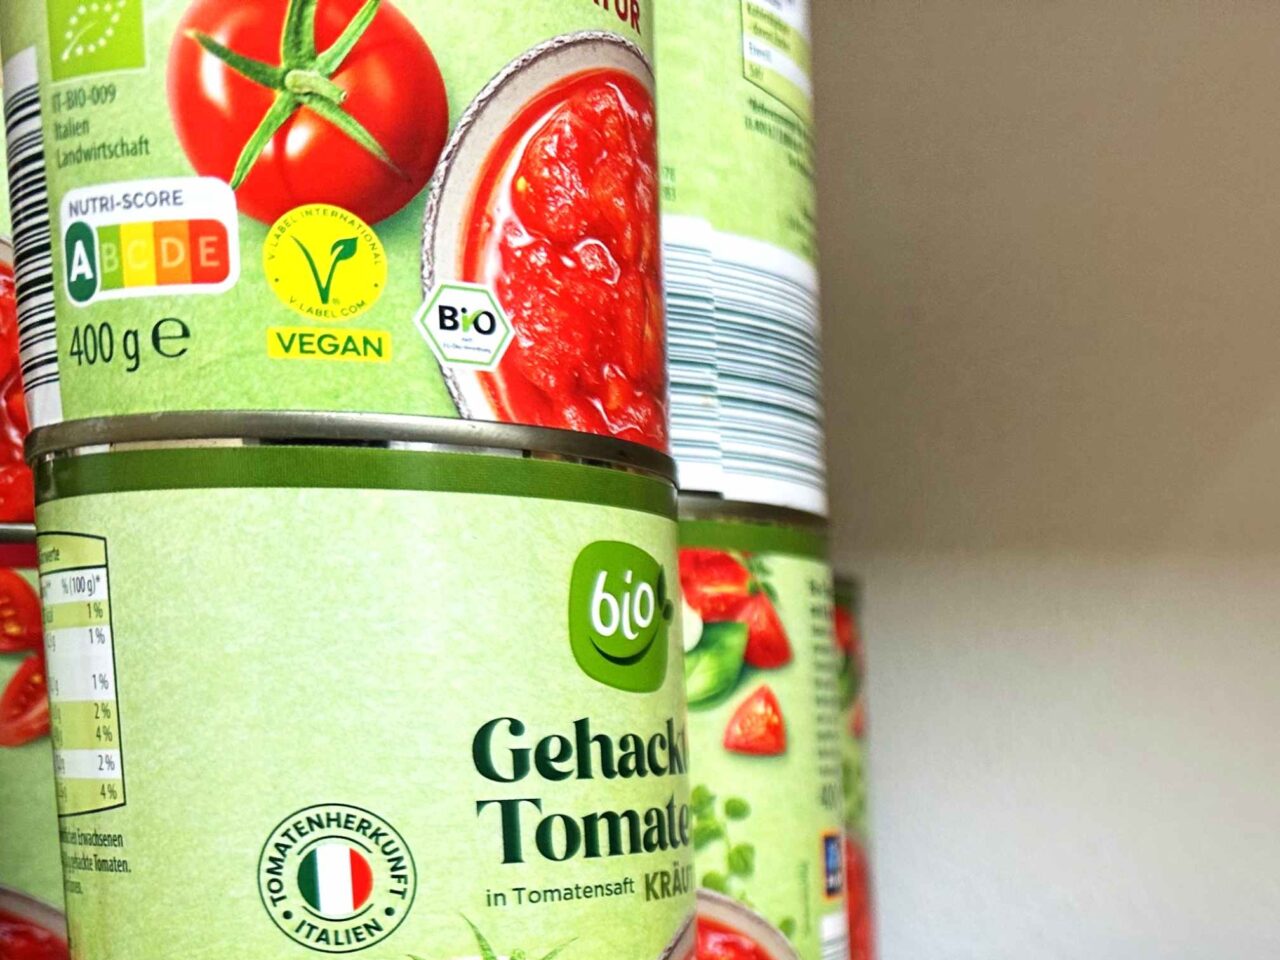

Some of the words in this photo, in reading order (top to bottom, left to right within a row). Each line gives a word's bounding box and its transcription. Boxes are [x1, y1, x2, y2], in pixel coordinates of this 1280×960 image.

[51, 83, 117, 113] IT-BIO-009
[54, 118, 90, 141] Italien
[57, 135, 151, 169] Landwirtschaft
[68, 190, 184, 217] NUTRI-SCORE
[70, 239, 94, 282] A
[101, 242, 119, 273] B
[127, 239, 149, 270] C
[160, 236, 186, 268] D
[198, 236, 220, 267] E
[69, 322, 114, 366] 400
[123, 329, 140, 372] g
[276, 332, 383, 357] VEGAN
[591, 569, 655, 640] bio
[266, 812, 408, 907] TOMATENHERKUNFT
[486, 889, 506, 907] in
[512, 877, 636, 905] Tomatensaft
[294, 918, 383, 946] ITALIEN
